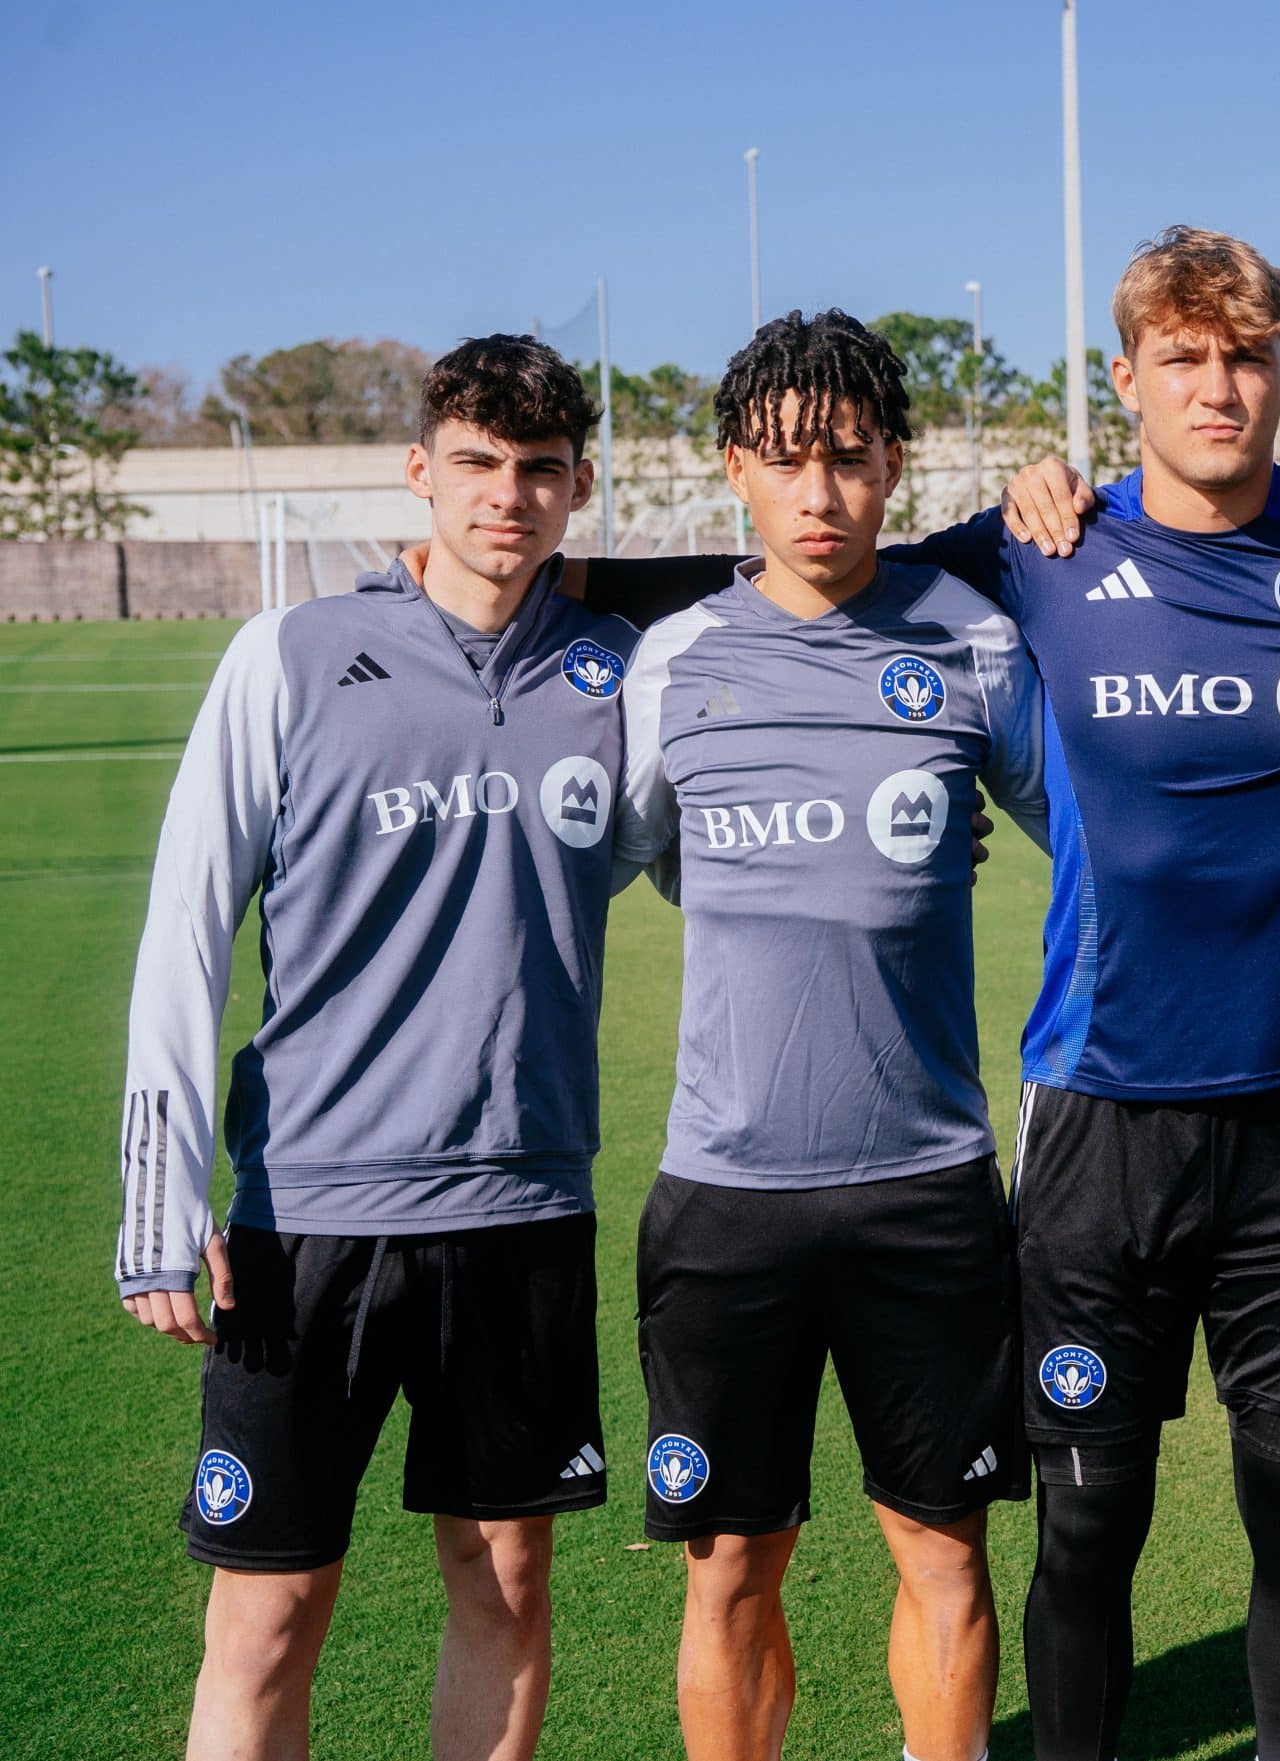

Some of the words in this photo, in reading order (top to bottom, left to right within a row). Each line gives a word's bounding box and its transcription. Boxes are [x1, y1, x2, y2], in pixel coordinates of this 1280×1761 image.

[576, 645, 620, 669] MONTRÉAL
[884, 675, 892, 687] CF
[891, 661, 938, 687] MONTRÉAL
[1089, 673, 1253, 718] BMO
[367, 771, 519, 836] BMO
[701, 799, 844, 850] BMO
[1046, 1361, 1054, 1373] CF
[1055, 1351, 1099, 1376] MONTRÉAL
[654, 1449, 661, 1461] CF
[661, 1440, 702, 1469] MONTRÉAL
[207, 1457, 246, 1490] MONTRÉAL
